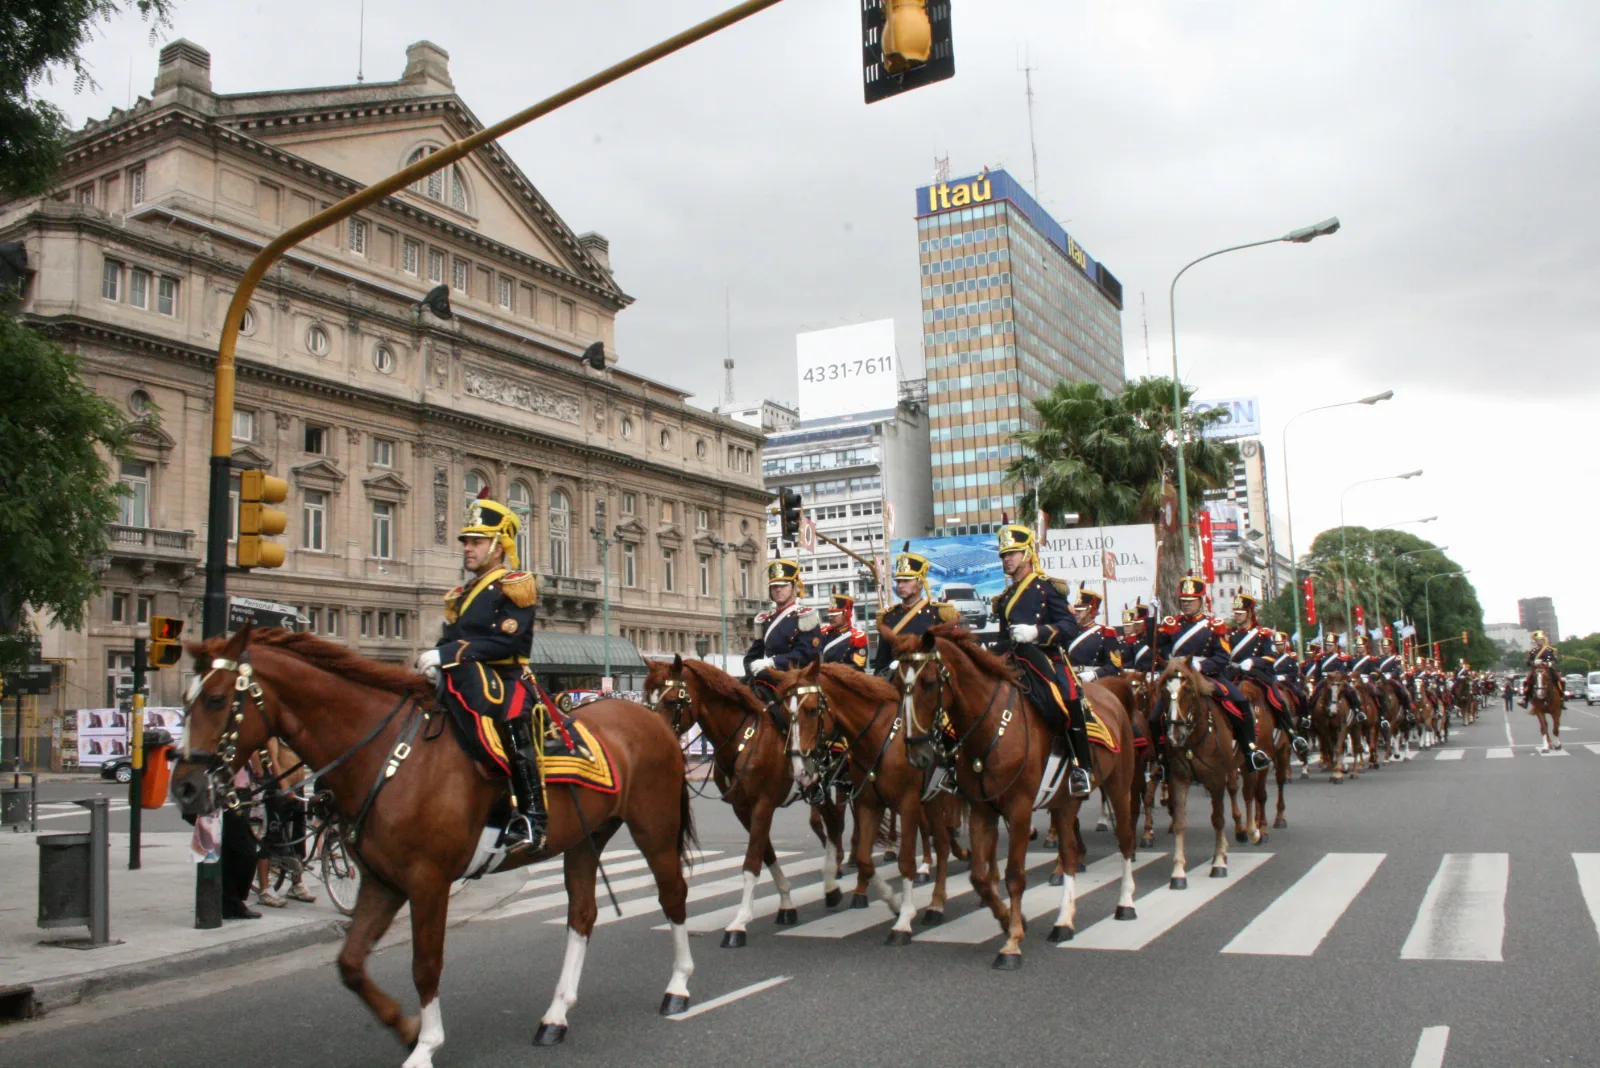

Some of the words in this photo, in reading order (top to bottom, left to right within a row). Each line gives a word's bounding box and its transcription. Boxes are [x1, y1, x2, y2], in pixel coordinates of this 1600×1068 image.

[929, 174, 992, 212] Itaú
[803, 356, 892, 383] 4331-7611
[1038, 556, 1056, 570] DE
[1060, 555, 1078, 569] LA
[1083, 551, 1144, 568] DÉADA.
[244, 600, 274, 611] Personal
